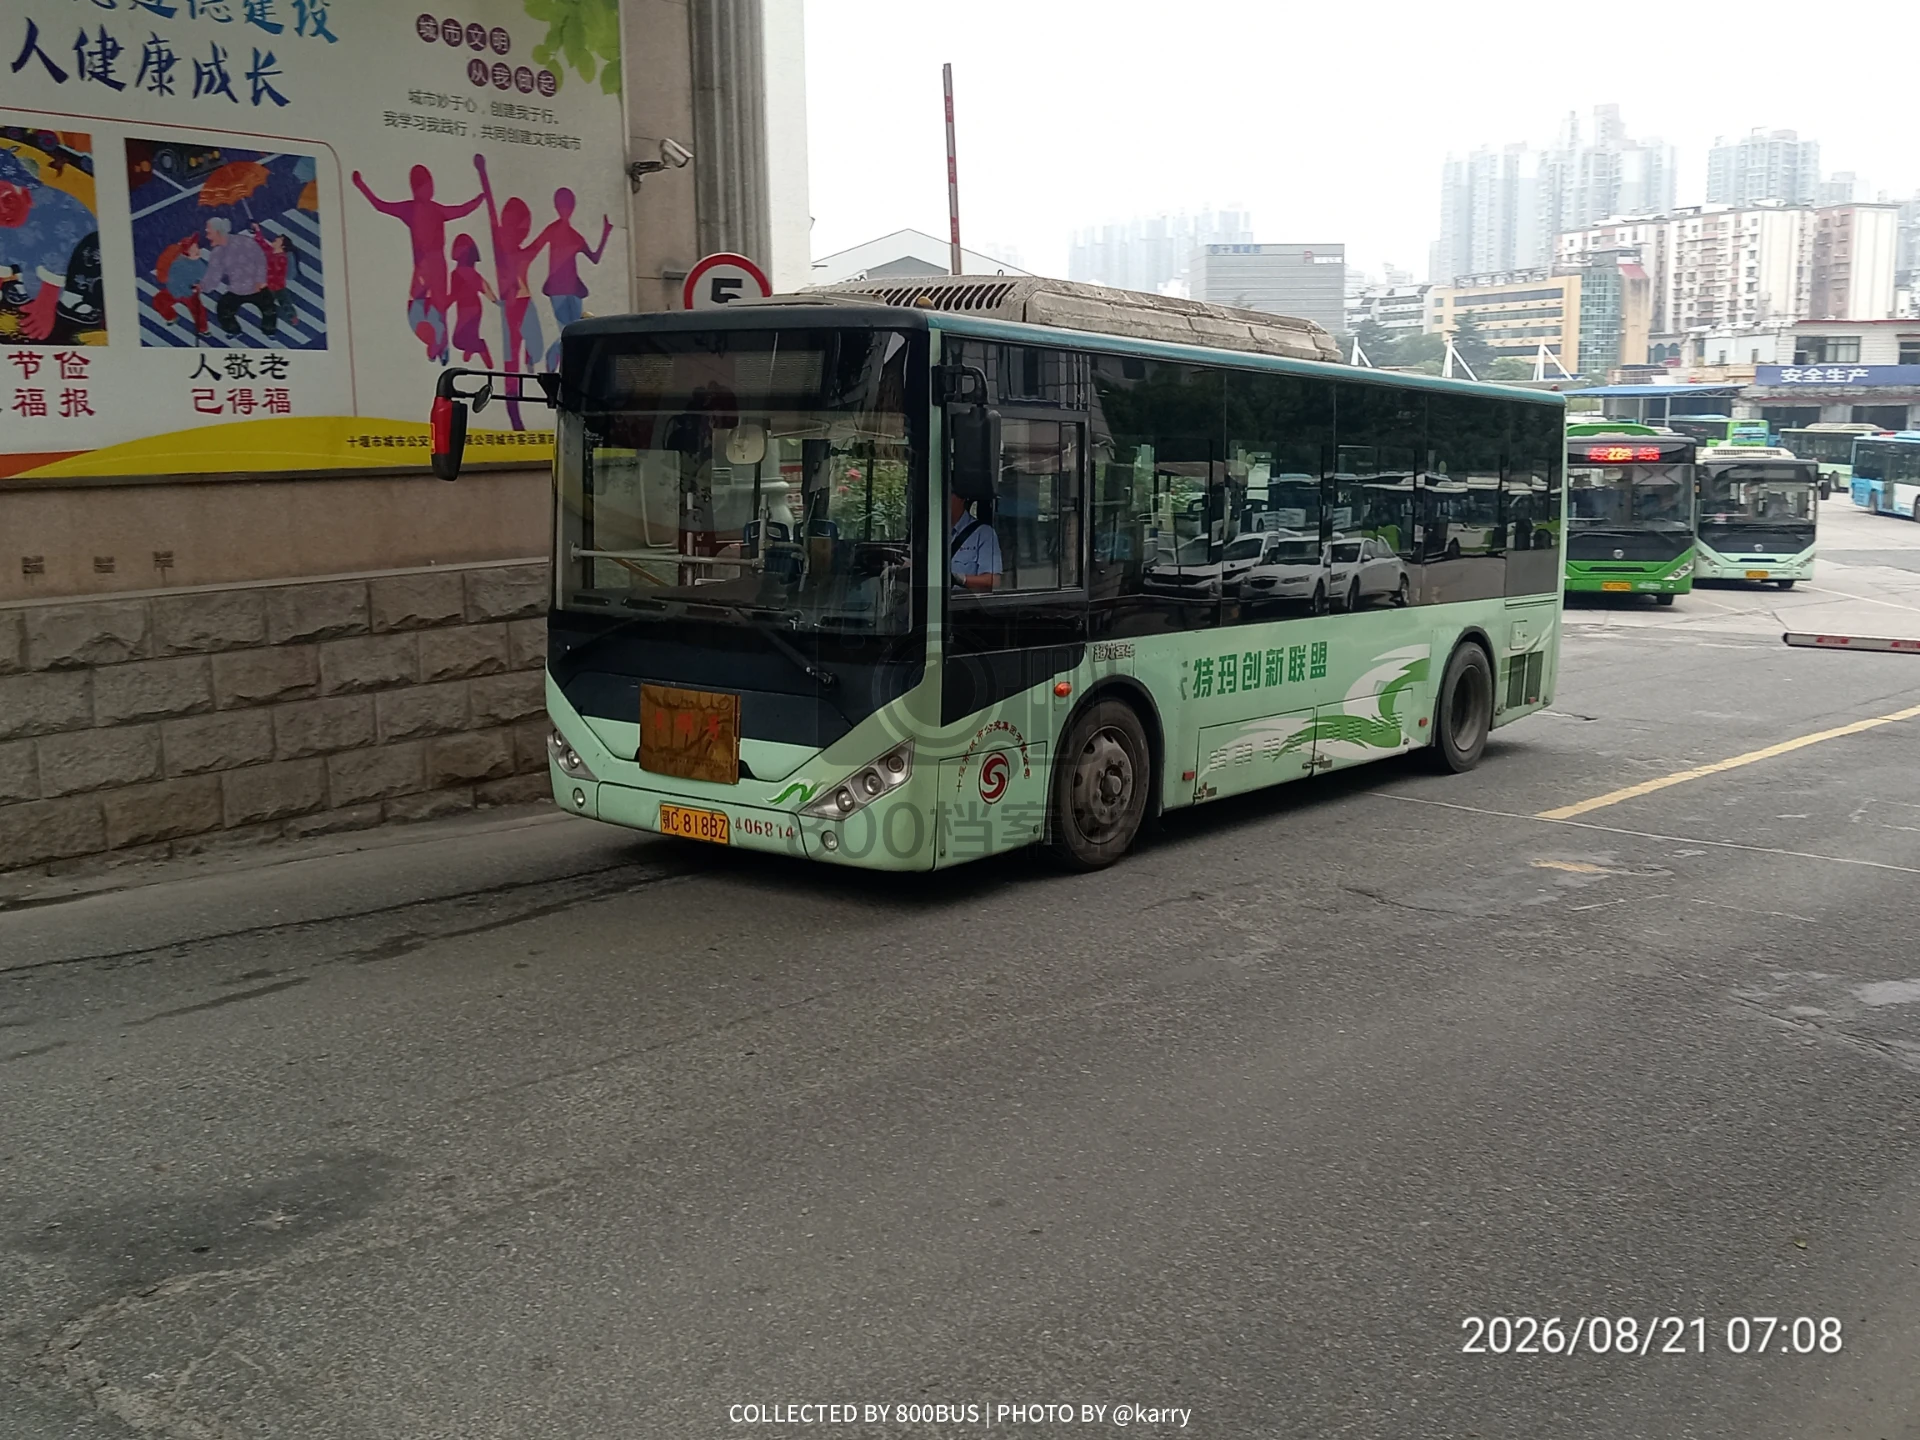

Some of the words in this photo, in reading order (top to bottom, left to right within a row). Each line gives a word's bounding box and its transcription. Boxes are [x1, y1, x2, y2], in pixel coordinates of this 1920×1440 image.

[11, 17, 291, 107] 人健康成长
[189, 353, 290, 381] 人敬老
[1780, 367, 1869, 383] 安全生产
[191, 387, 292, 415] 己得福
